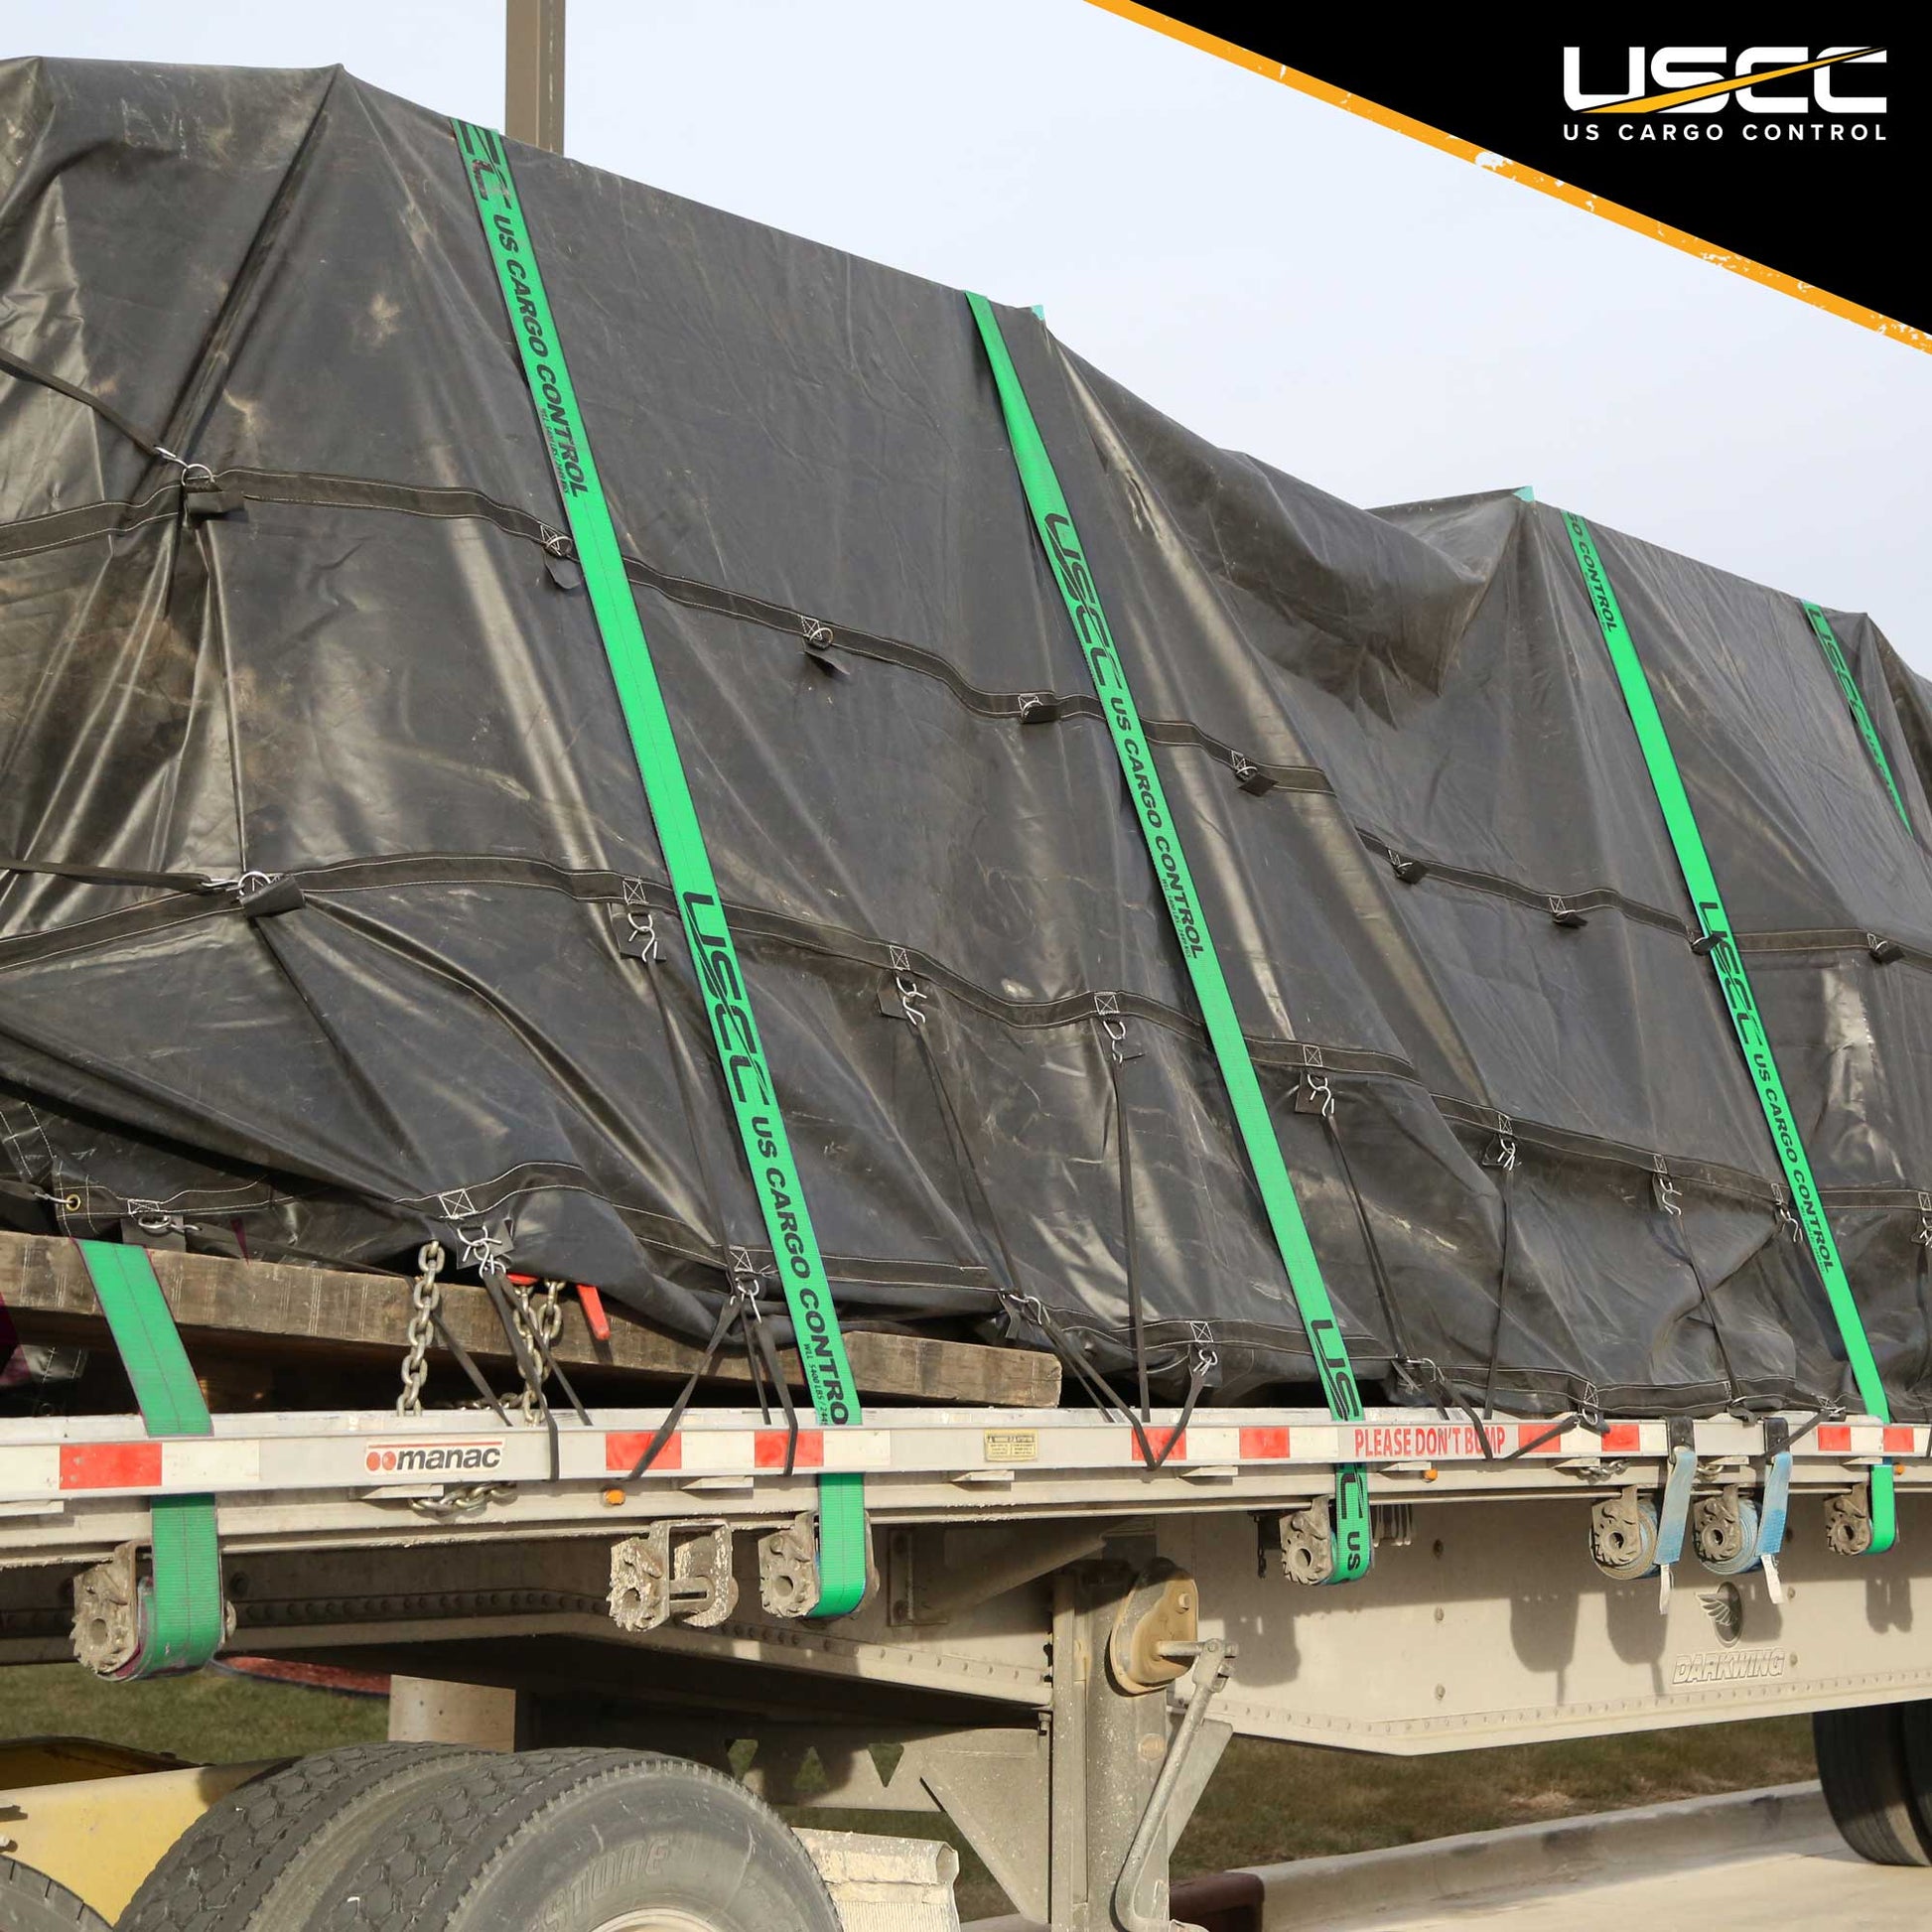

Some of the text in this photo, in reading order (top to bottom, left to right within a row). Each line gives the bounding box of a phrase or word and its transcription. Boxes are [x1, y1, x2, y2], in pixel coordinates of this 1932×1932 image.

[493, 213, 519, 253] US
[506, 258, 549, 358] CARGO
[536, 363, 588, 498] CONTROL
[1579, 541, 1617, 633] CONTROL
[1044, 512, 1204, 959] USCC US CARGO CONTROL
[683, 892, 849, 1425] USCC US CARGO CONTRO
[1753, 1053, 1771, 1082] US
[1765, 1087, 1798, 1164] CARGO
[1794, 1170, 1834, 1274] CONTROL
[803, 1342, 813, 1360] WLL
[808, 1362, 819, 1384] 5400
[814, 1383, 824, 1400] LBS
[818, 1405, 830, 1427] 244
[396, 1448, 500, 1470] manac
[1354, 1426, 1506, 1457] PLEASE DON'T BUMP
[1347, 1531, 1361, 1571] US
[1672, 1648, 1785, 1685] DARKWING
